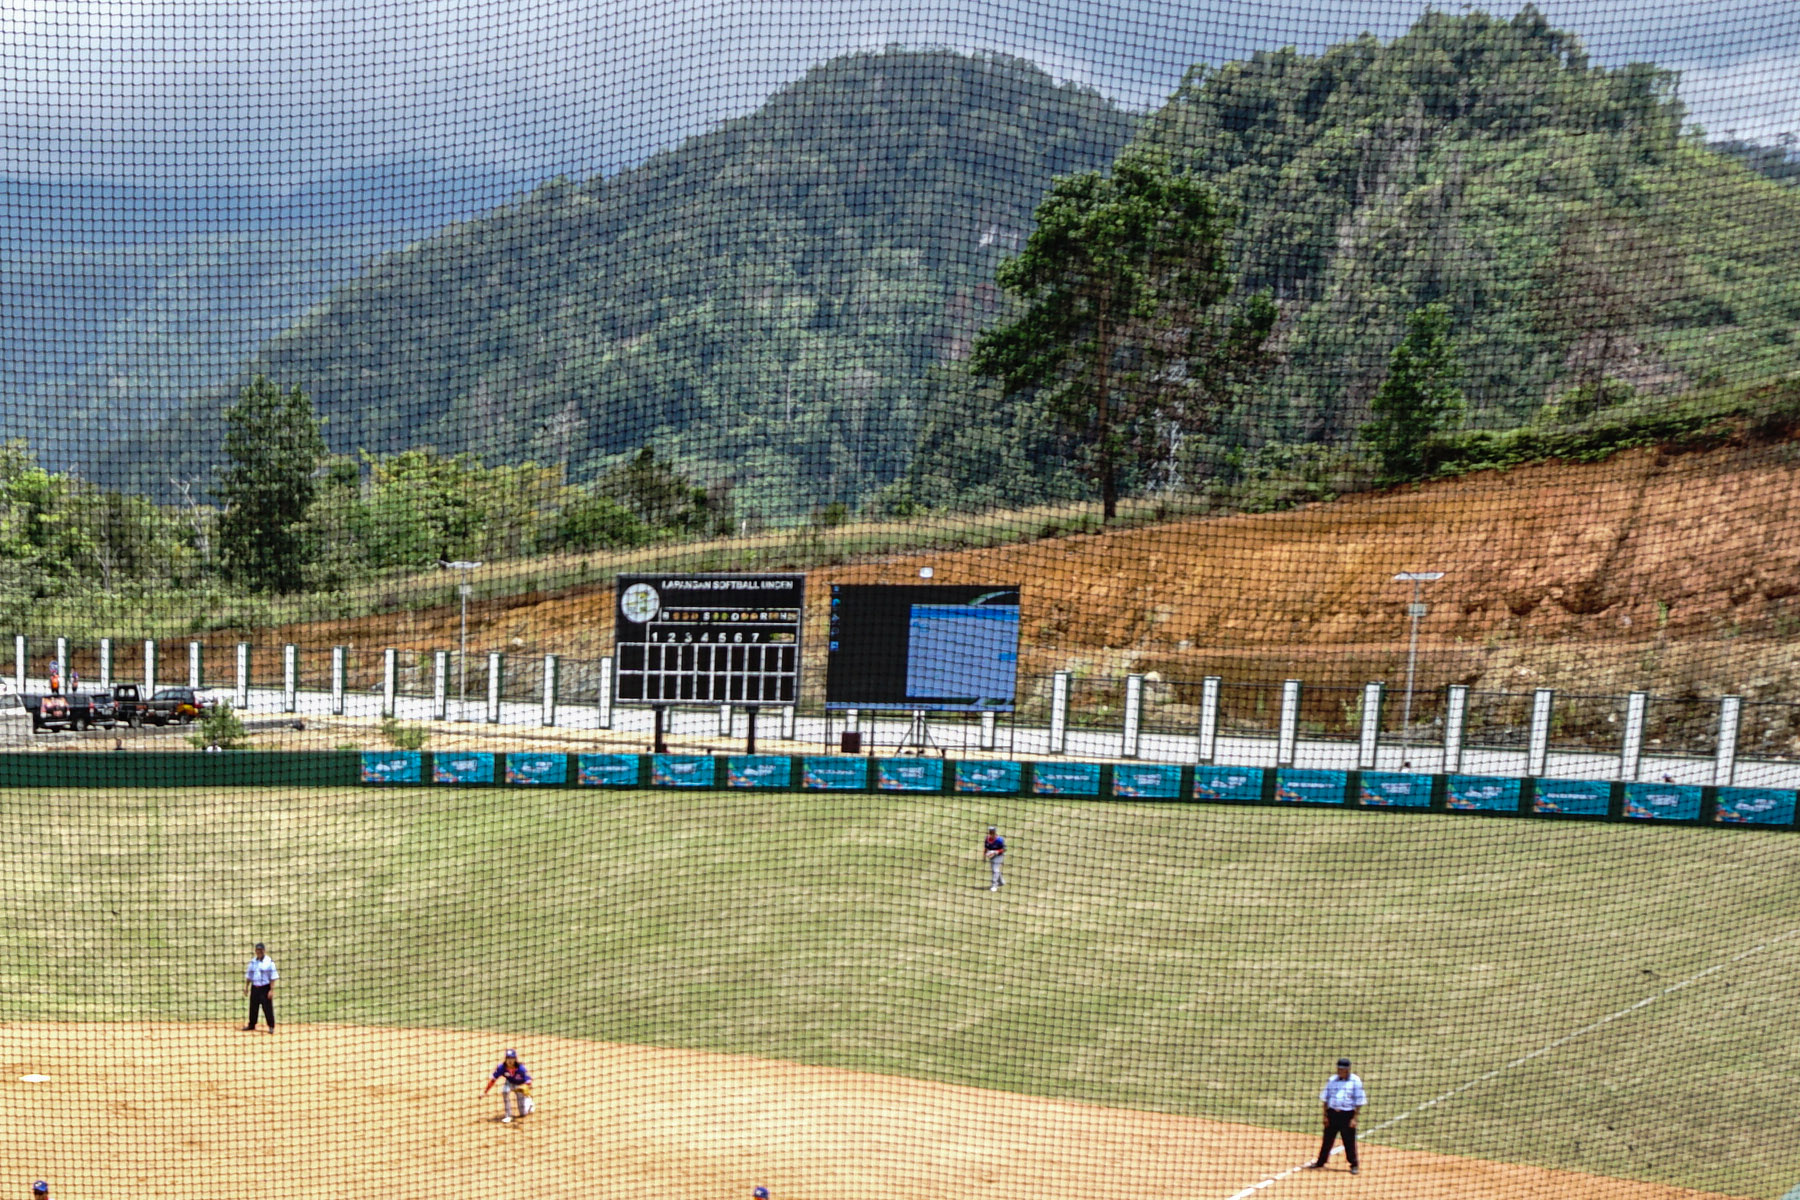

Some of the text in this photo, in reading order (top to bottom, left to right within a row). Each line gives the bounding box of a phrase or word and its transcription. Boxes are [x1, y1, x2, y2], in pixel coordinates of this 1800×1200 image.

[661, 580, 711, 590] LAPANGAN
[712, 580, 760, 590] SOFTBALL
[652, 632, 760, 643] 1 2 3 4 5 6 7
